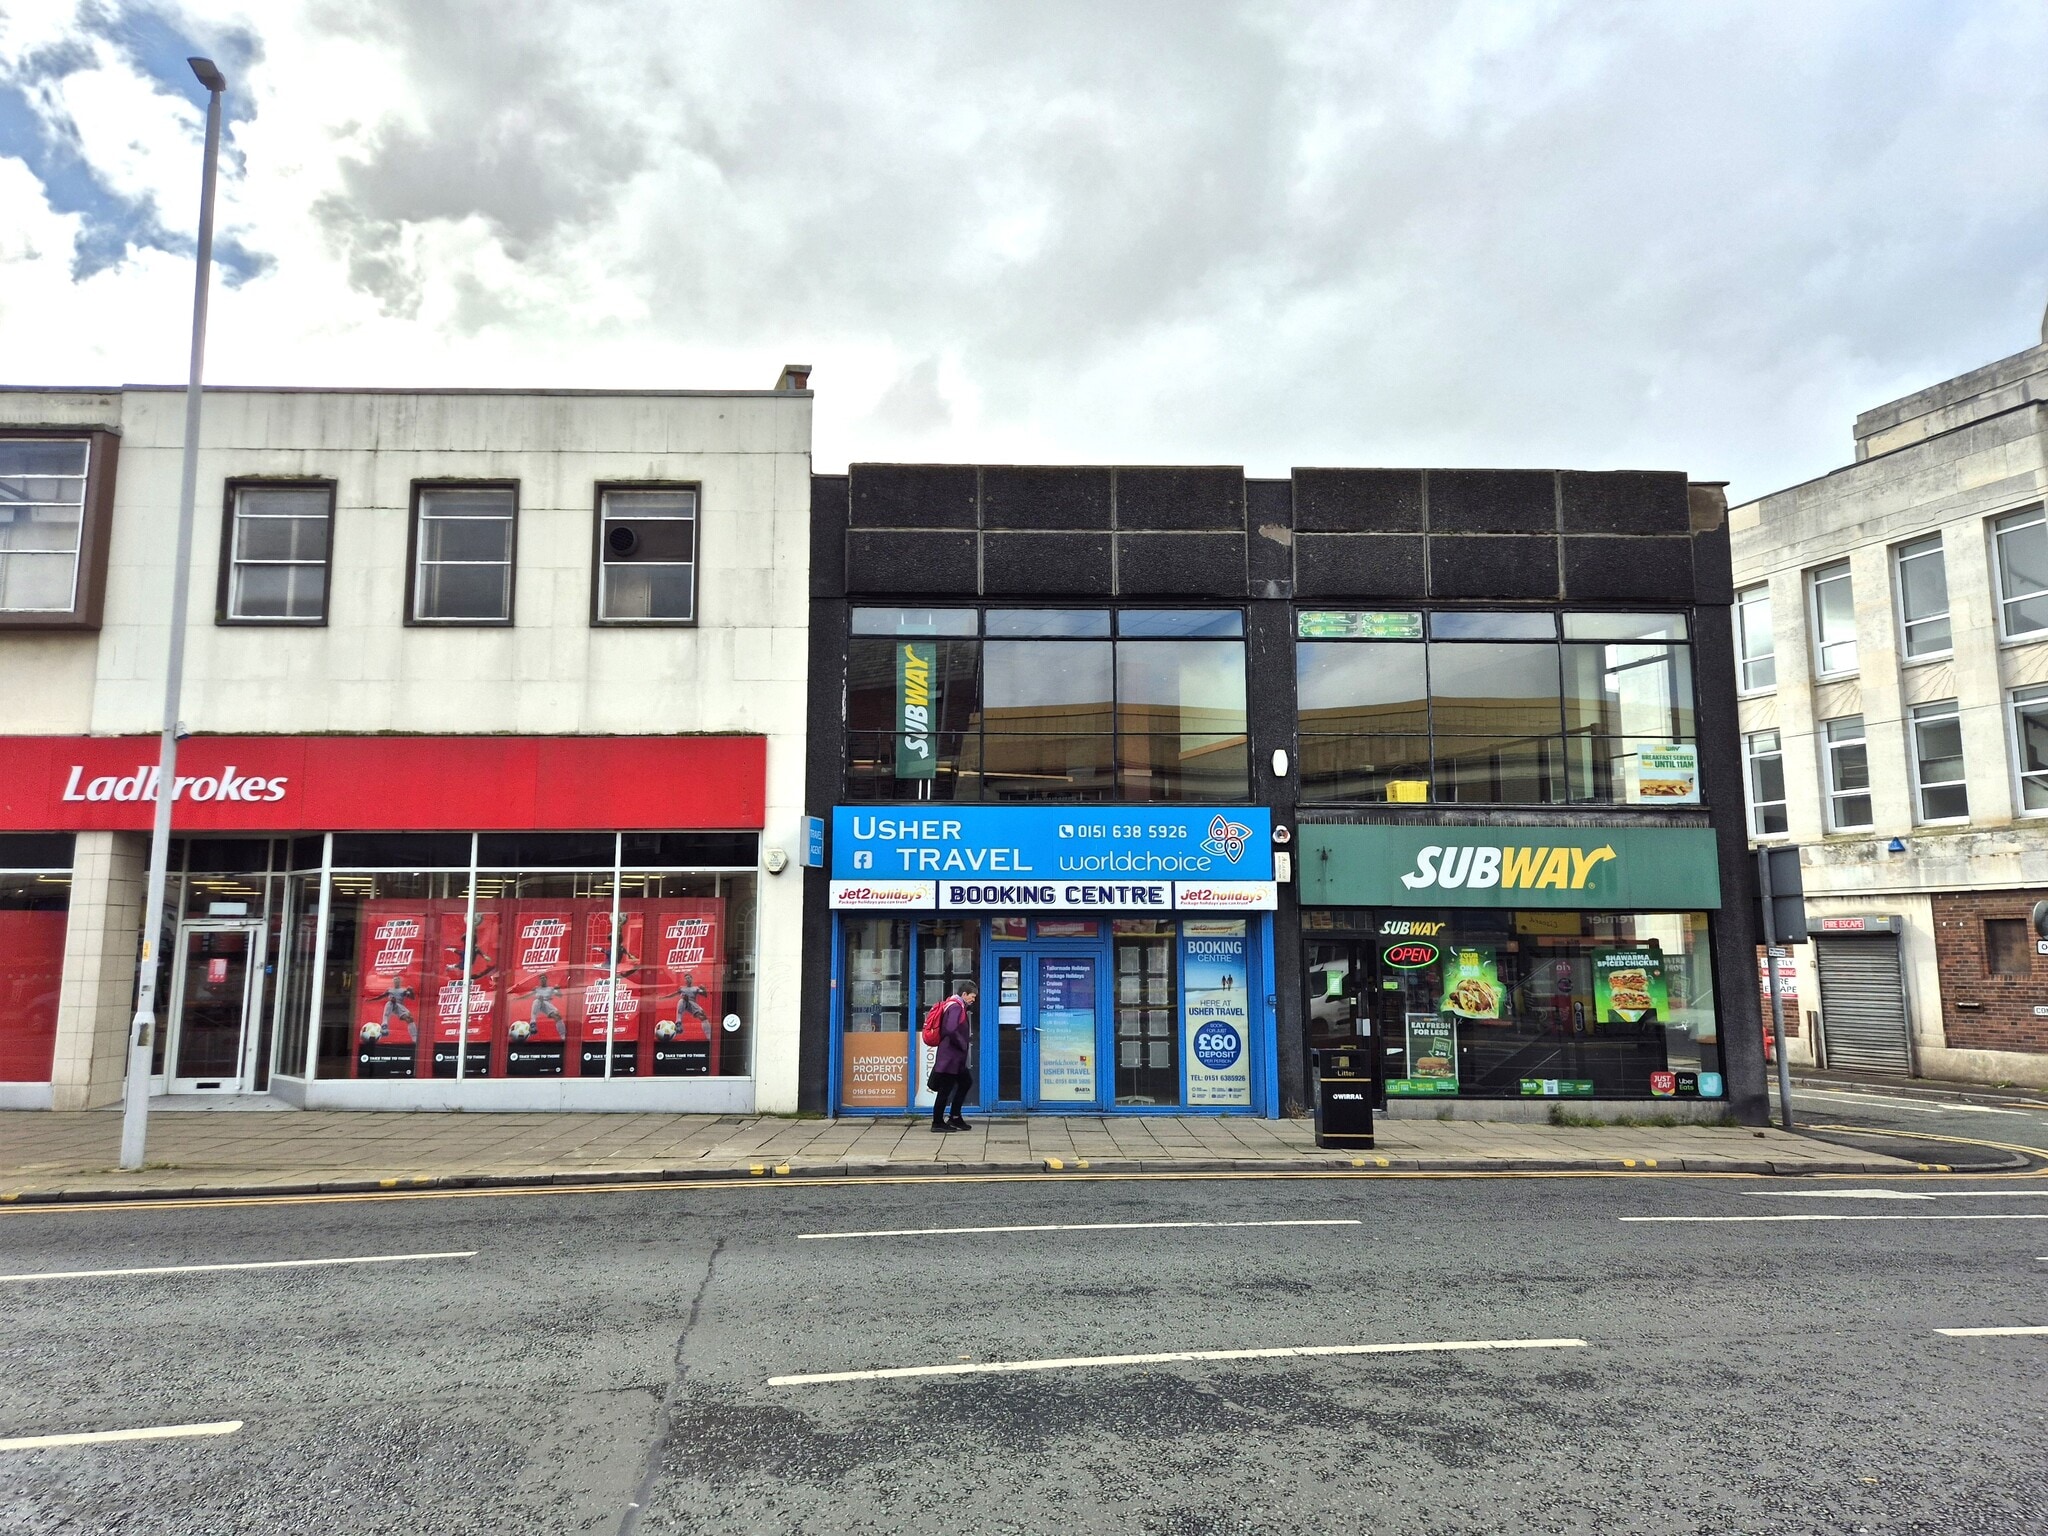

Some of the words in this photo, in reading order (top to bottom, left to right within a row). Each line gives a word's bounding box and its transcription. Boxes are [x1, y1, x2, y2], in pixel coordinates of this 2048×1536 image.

[904, 644, 929, 760] SUBWAY
[1077, 825, 1106, 838] 0151
[1112, 825, 1142, 838] 638
[1148, 825, 1188, 838] 5926
[896, 848, 1033, 871] TRAVEL
[1059, 850, 1212, 872] worldchoice
[1400, 844, 1617, 890] SUBWAY
[950, 886, 1056, 904] BOOKING
[1065, 886, 1164, 905] CENTRE
[1379, 920, 1446, 936] SUBWAY
[1839, 920, 1863, 928] ESCAPE
[377, 927, 393, 938] IT'S
[393, 926, 418, 937] MAKE
[524, 927, 539, 937] IT'S
[540, 925, 564, 936] MAKE
[668, 927, 684, 937] IT'S
[684, 925, 708, 936] MAKE
[388, 938, 403, 950] OR
[534, 937, 550, 949] OR
[679, 937, 694, 949] OR
[1187, 941, 1242, 954] BOOKING
[377, 951, 413, 964] BREAK
[524, 950, 558, 963] BREAK
[669, 950, 703, 963] BREAK
[1197, 954, 1232, 962] CENTRE
[1390, 949, 1432, 962] OPEN
[441, 1003, 457, 1014] BET
[588, 1003, 604, 1013] BET
[1200, 999, 1220, 1007] HERE
[1188, 1008, 1214, 1016] USHER
[1216, 1007, 1245, 1016] TRAVEL
[1198, 1033, 1237, 1051] £60
[853, 1056, 908, 1065] LANDWOOD
[853, 1065, 904, 1073] PROPERTY
[853, 1073, 903, 1082] AUCTIONS
